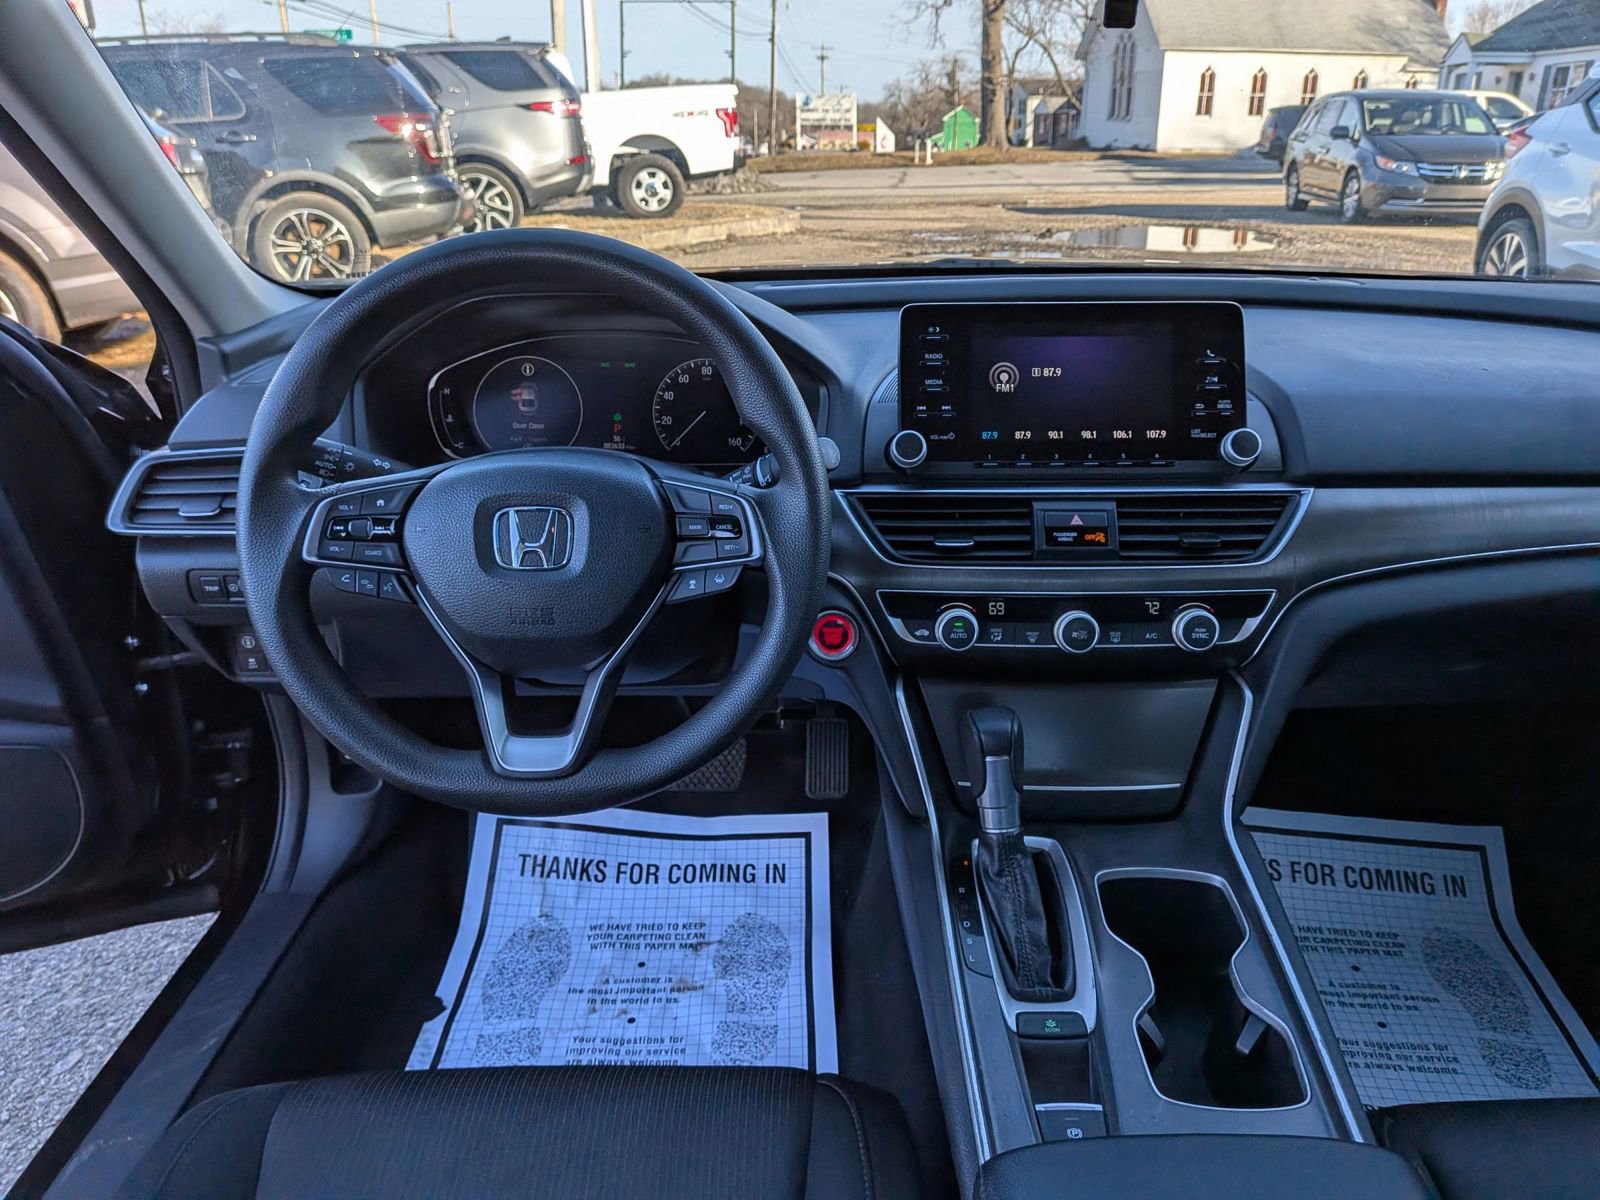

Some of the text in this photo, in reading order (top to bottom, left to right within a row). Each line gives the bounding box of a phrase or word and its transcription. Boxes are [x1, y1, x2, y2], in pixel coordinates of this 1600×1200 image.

[701, 366, 712, 375] 80
[1043, 368, 1062, 377] 87.9
[678, 374, 689, 383] 60
[996, 384, 1015, 393] FM1
[663, 391, 674, 400] 40
[661, 416, 672, 425] 20
[982, 430, 1166, 440] 87.9 87.9 90.1 98.1 106.1 107.9
[728, 437, 742, 447] 160
[988, 602, 1005, 615] 69
[1145, 601, 1160, 615] 72
[518, 853, 786, 885] THANKS FOR COMING IN
[1290, 861, 1336, 887] FOR
[1343, 865, 1436, 897] COMING
[1443, 874, 1468, 898] IN
[589, 922, 706, 932] WE HAVE TRIED TO KEEP
[586, 932, 706, 942] YOUR CARPETING CLEAN
[966, 937, 973, 945] S
[590, 942, 616, 951] WITH
[619, 942, 640, 951] THIS
[643, 942, 676, 951] PAPER
[1301, 945, 1319, 953] ITH
[969, 954, 976, 962] L
[603, 975, 673, 985] A customer is
[567, 986, 584, 995] the
[587, 986, 613, 996] most
[615, 986, 666, 996] important
[586, 997, 597, 1006] in
[600, 996, 617, 1006] the
[620, 996, 649, 1005] world
[652, 996, 663, 1005] to
[572, 1035, 684, 1047] Your suggestions for
[565, 1045, 687, 1057] improving our service
